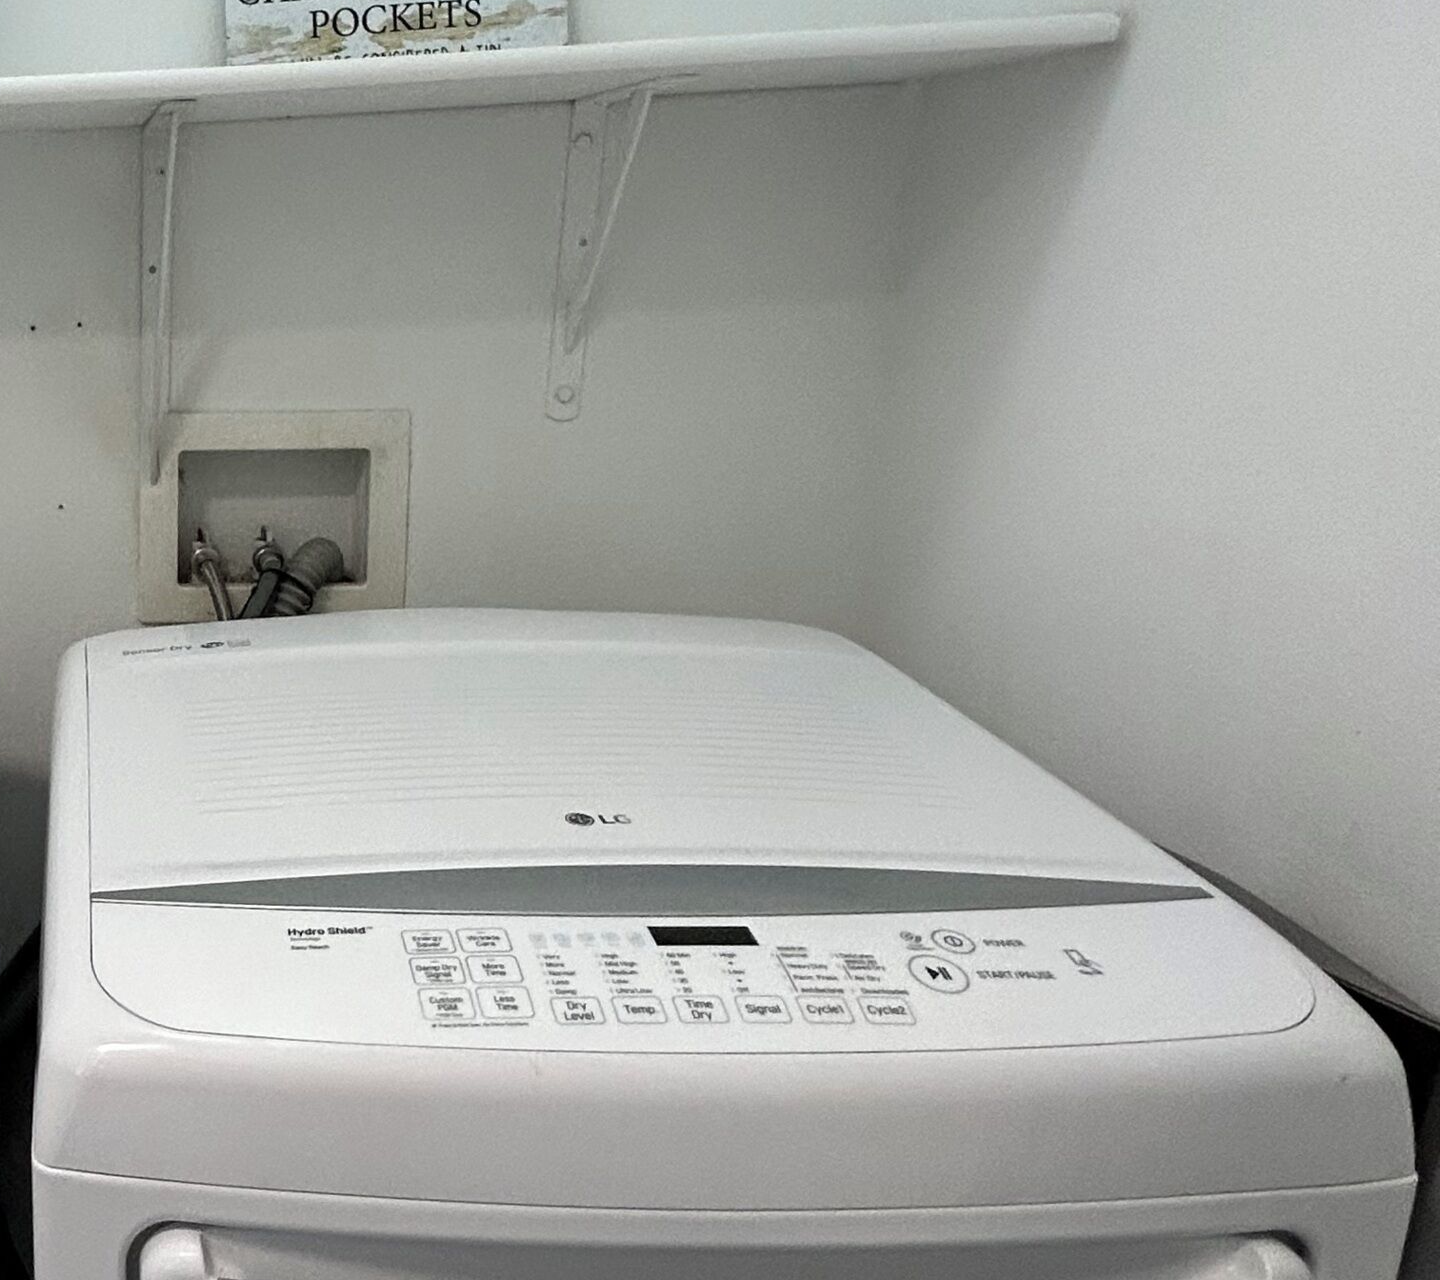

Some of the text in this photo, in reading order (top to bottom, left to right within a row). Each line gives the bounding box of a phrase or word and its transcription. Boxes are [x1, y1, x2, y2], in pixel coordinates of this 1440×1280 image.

[598, 814, 632, 824] LG
[287, 927, 366, 937] Hydro Shield
[983, 939, 1026, 947] POWER
[441, 964, 457, 972] Dry
[429, 996, 464, 1004] Custom
[493, 995, 516, 1003] Less
[684, 999, 714, 1009] Time
[437, 1003, 458, 1011] PGM
[566, 1000, 587, 1011] Dry
[623, 1005, 656, 1016] Temp
[745, 1003, 782, 1016] Signal
[806, 1004, 845, 1016] Cycle1
[867, 1004, 908, 1016] Cycle2
[564, 1011, 595, 1021] Level
[691, 1010, 712, 1021] Dry
